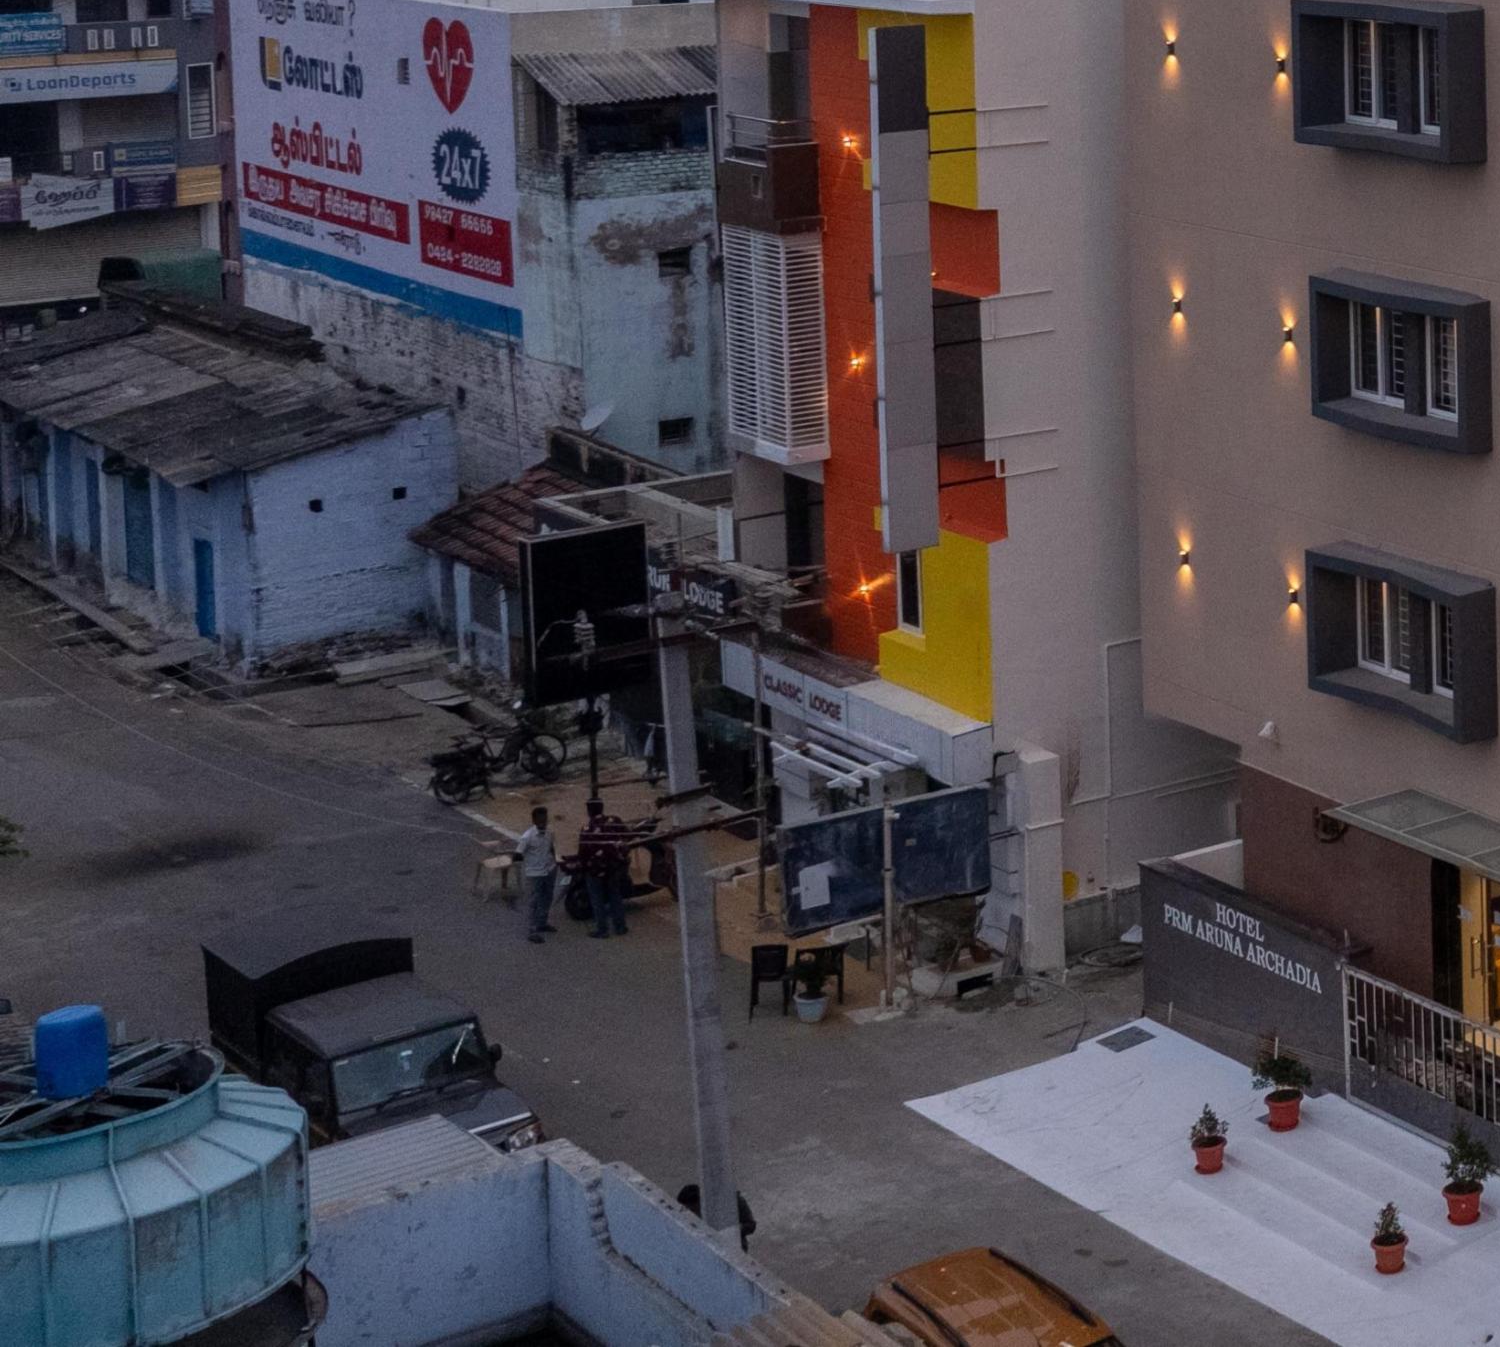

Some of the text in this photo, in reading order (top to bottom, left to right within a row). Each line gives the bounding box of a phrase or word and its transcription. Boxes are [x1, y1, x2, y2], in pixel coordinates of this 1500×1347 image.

[439, 143, 482, 191] 24x7
[683, 578, 725, 614] LODGE
[765, 674, 842, 721] CLASSIC LODGE
[1215, 902, 1265, 943] HOTEL
[1163, 904, 1322, 994] PRM ARUNA ARCHADIA
